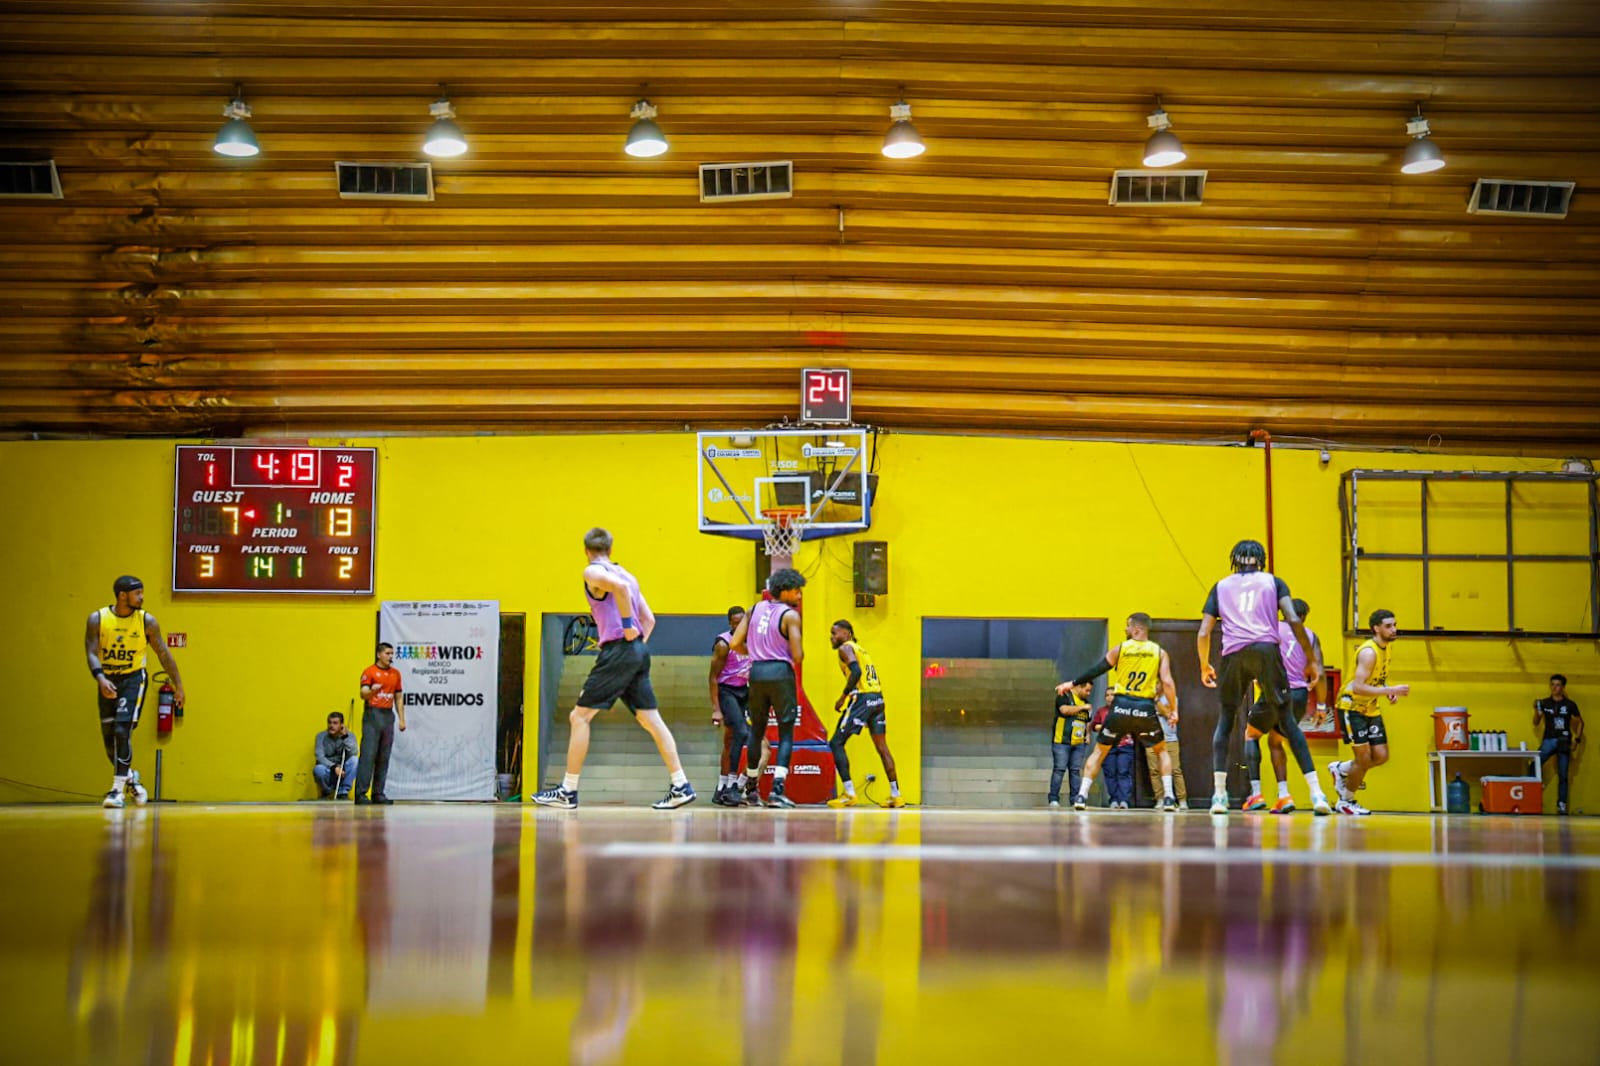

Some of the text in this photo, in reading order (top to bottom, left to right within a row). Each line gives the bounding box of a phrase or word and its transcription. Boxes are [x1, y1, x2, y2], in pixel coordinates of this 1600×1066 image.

[809, 375, 844, 403] 24
[197, 453, 216, 462] TOL
[336, 455, 354, 463] TOL
[257, 453, 314, 481] 4:19
[207, 464, 214, 485] 1
[338, 466, 352, 487] 2
[192, 491, 245, 503] GUEST
[310, 492, 355, 504] HOME
[276, 502, 283, 524] 1
[222, 507, 239, 535] 7
[329, 508, 352, 536] 13
[252, 528, 298, 538] PERIOD
[189, 545, 220, 553] FOULS
[241, 546, 308, 554] PLAYER-FOUL
[328, 546, 359, 555] FOULS
[200, 556, 214, 577] 3
[254, 556, 302, 578] 14 1
[339, 557, 353, 579] 2
[1239, 590, 1256, 612] 11
[438, 646, 475, 660] WRO
[412, 667, 465, 675] Regional Sinaloa
[429, 676, 448, 684] 2025
[1126, 671, 1147, 691] 22
[403, 693, 484, 706] IENVENIDOS
[1114, 706, 1148, 717] Soni Gas
[1510, 786, 1523, 800] G
